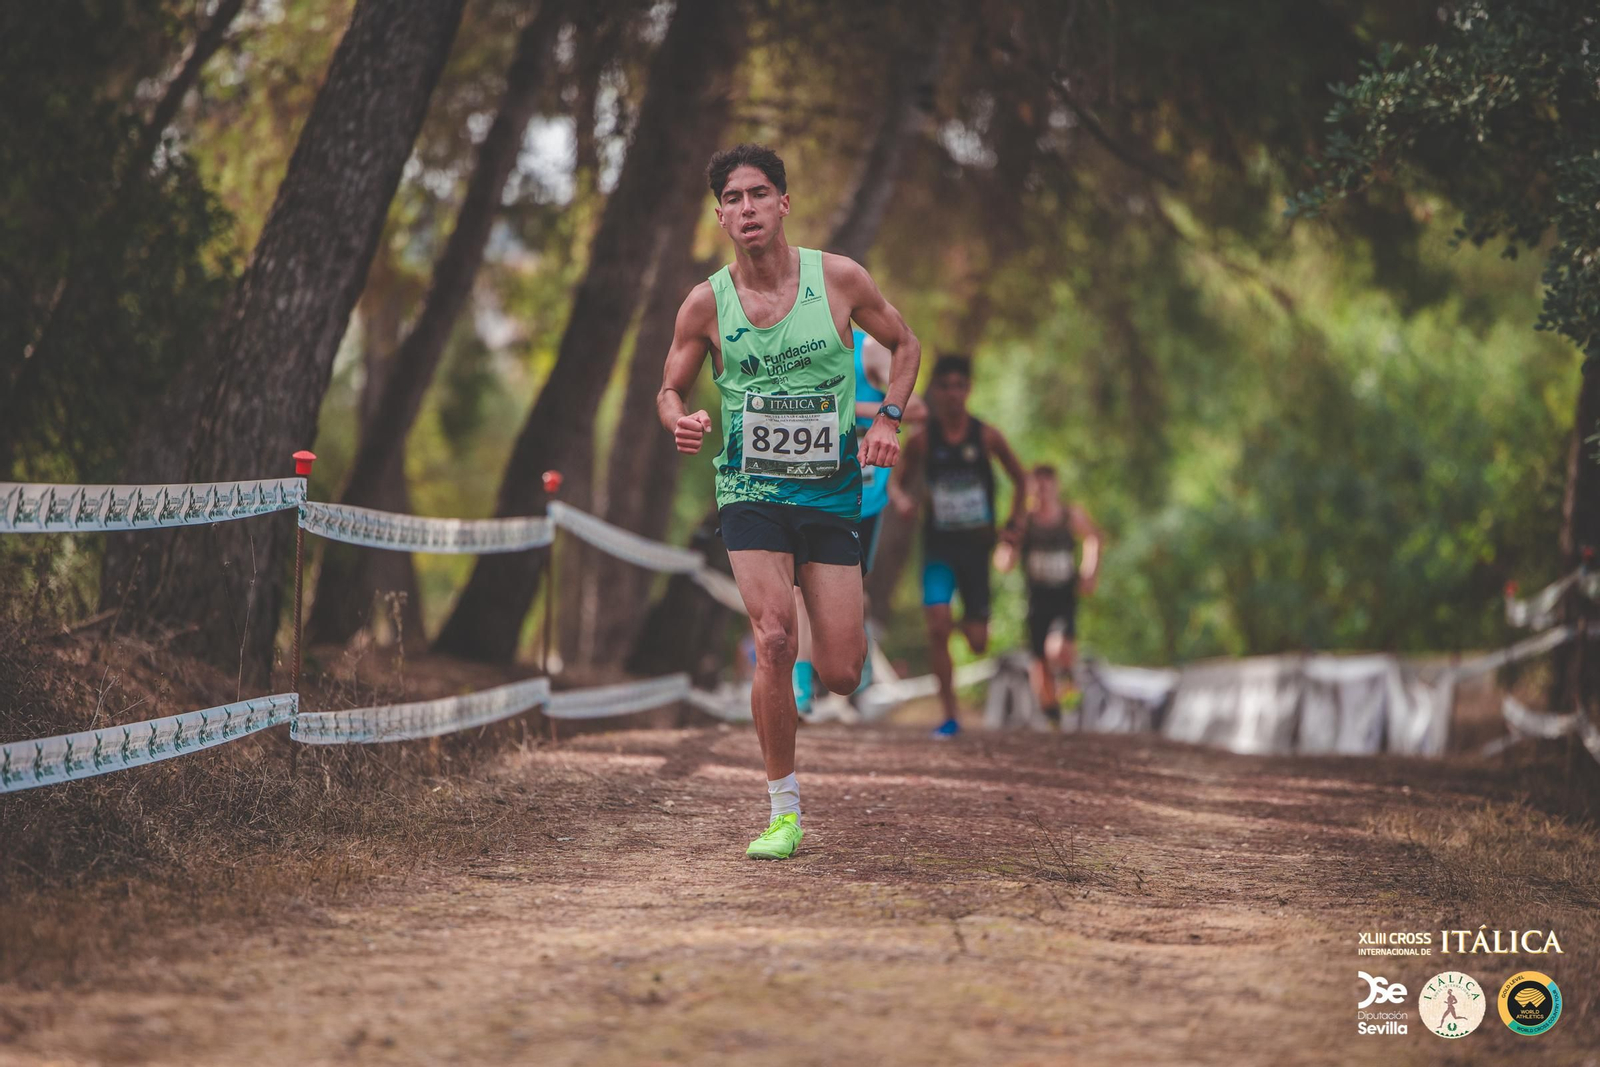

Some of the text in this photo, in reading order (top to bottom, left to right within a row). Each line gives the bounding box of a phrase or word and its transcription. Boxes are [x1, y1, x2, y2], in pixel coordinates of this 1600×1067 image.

[763, 338, 827, 366] Fundación
[766, 356, 812, 377] Unicaja
[770, 397, 815, 409] ITÁLICA
[752, 425, 833, 455] 8294
